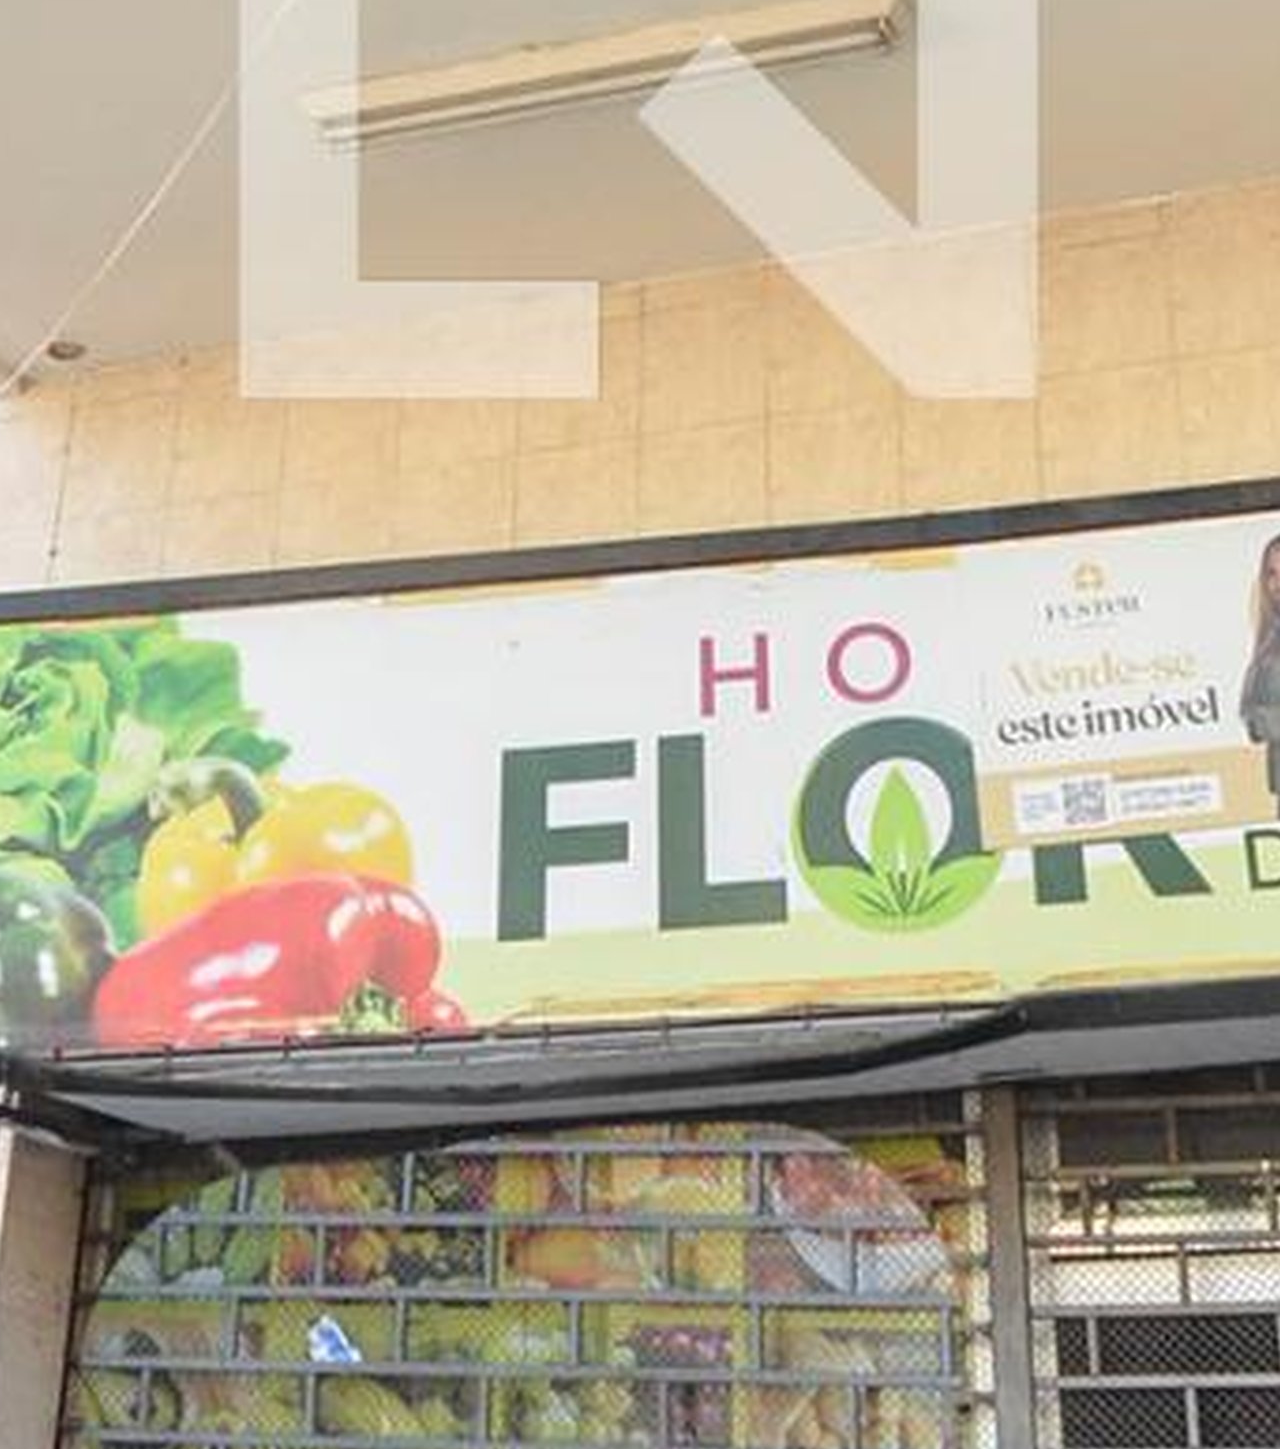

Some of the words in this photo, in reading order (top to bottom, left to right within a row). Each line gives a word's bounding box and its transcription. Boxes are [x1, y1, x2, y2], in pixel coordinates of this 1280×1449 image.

[1007, 651, 1199, 695] Vende-se
[997, 712, 1077, 745] este
[1081, 686, 1221, 736] imóvel
